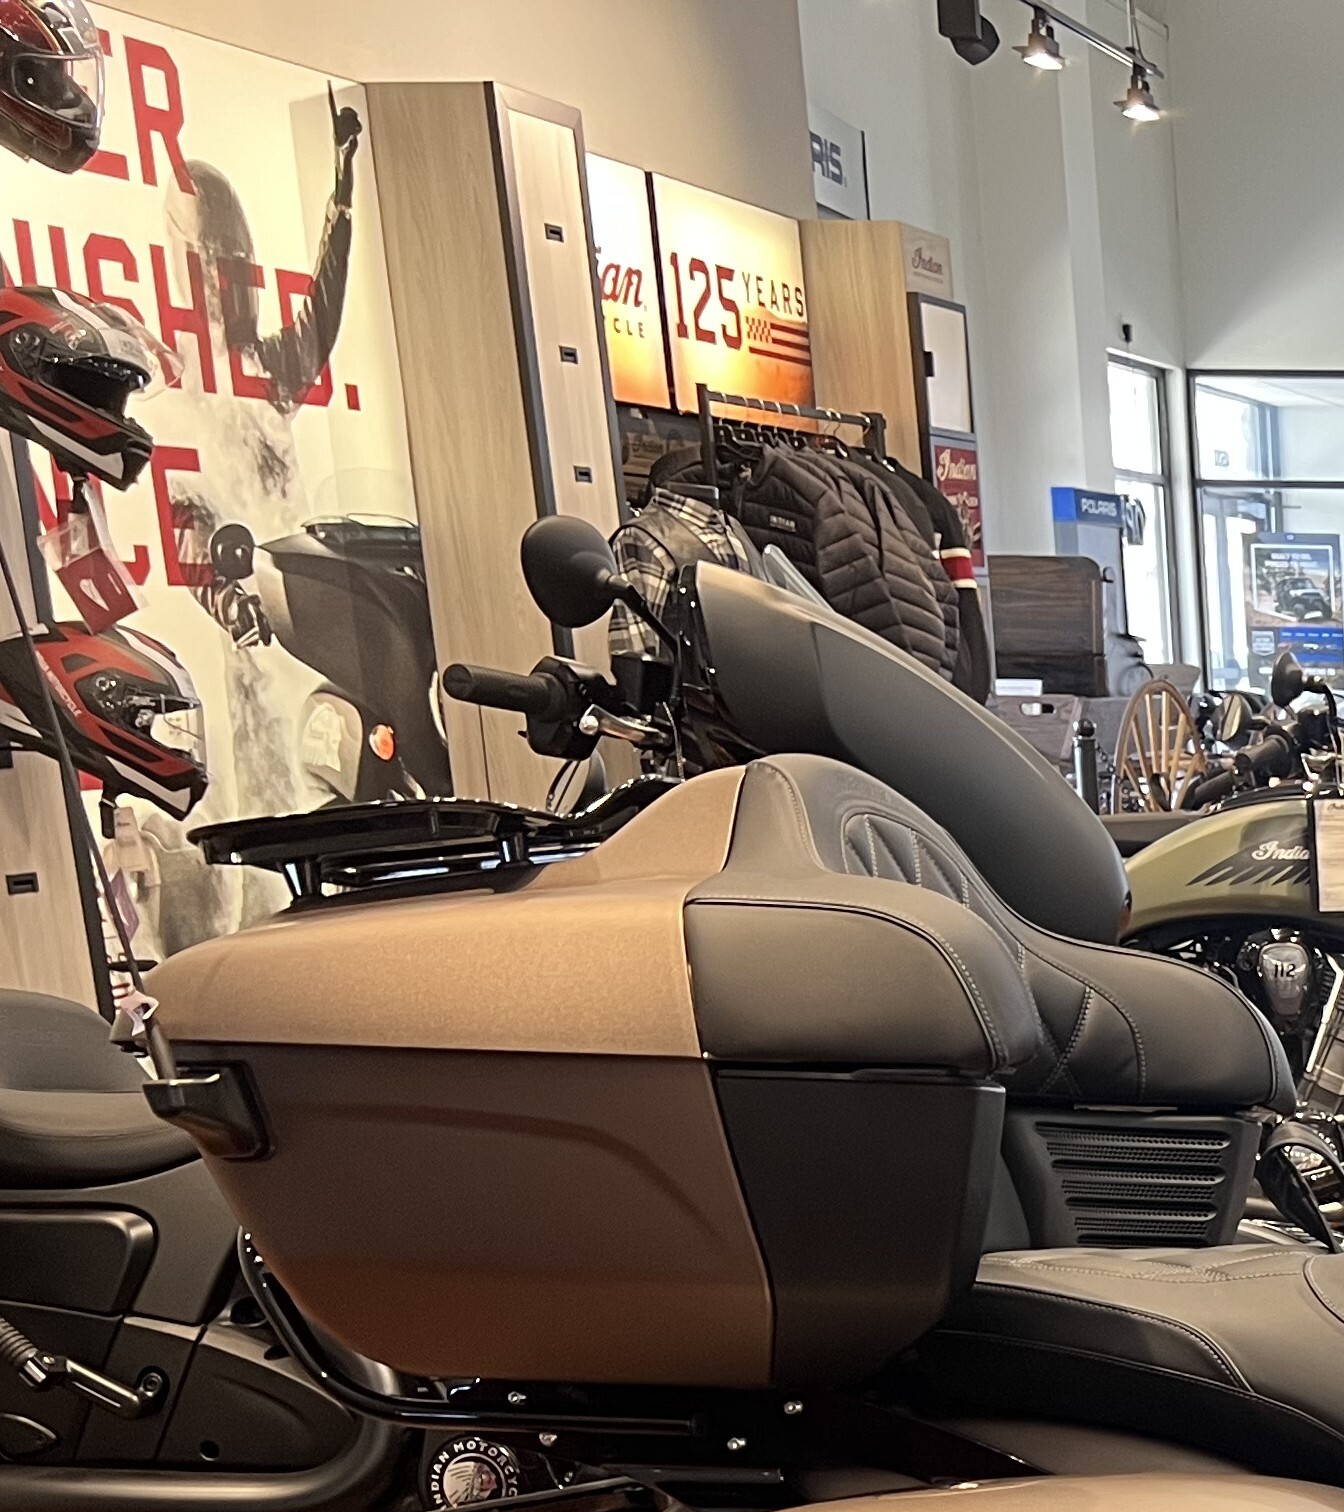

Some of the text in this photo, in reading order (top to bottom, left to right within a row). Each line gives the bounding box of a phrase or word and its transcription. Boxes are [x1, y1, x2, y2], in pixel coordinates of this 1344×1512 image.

[670, 251, 806, 351] 125 YEARS
[1274, 963, 1296, 978] 112
